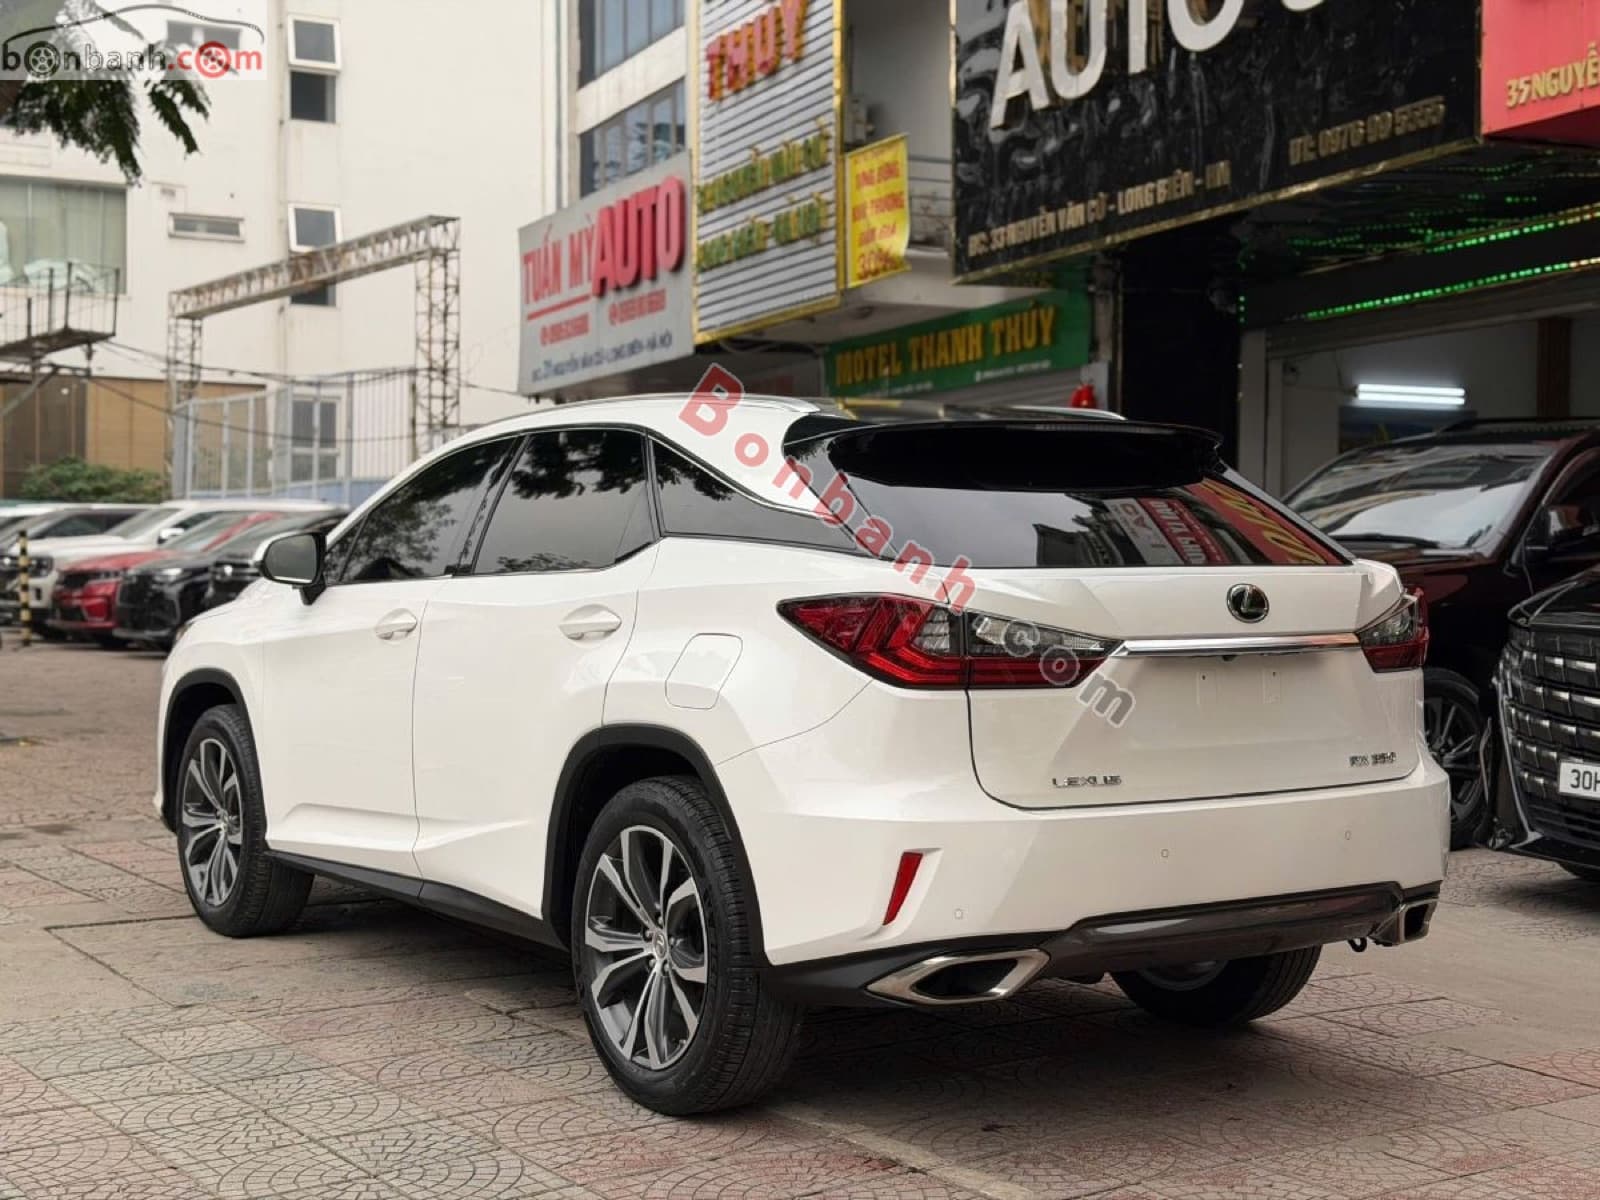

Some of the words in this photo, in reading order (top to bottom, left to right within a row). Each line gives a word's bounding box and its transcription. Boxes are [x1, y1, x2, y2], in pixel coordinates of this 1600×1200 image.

[1117, 182, 1155, 216] LONG
[592, 176, 686, 298] AUTO
[835, 341, 903, 386] MOTEL
[908, 321, 985, 372] THANH
[1052, 775, 1122, 789] LEXUS
